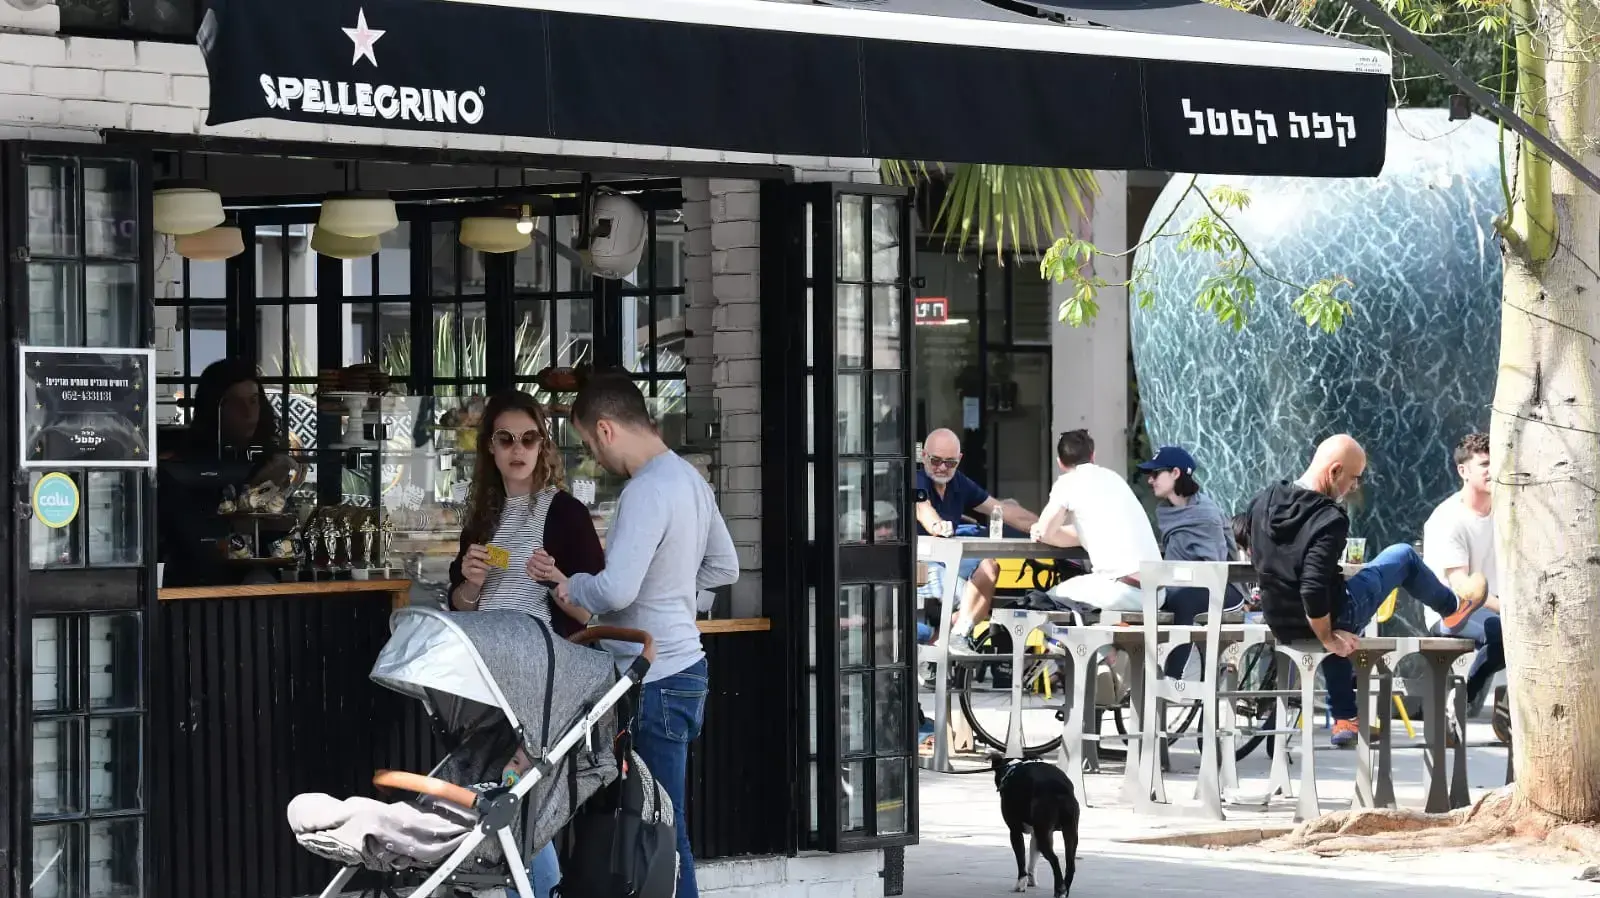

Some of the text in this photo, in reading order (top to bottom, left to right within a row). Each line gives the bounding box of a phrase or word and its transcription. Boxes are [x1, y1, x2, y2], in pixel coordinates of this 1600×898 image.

[259, 73, 485, 125] S.PELLEGRINO
[1181, 98, 1357, 148] קפה קסטל
